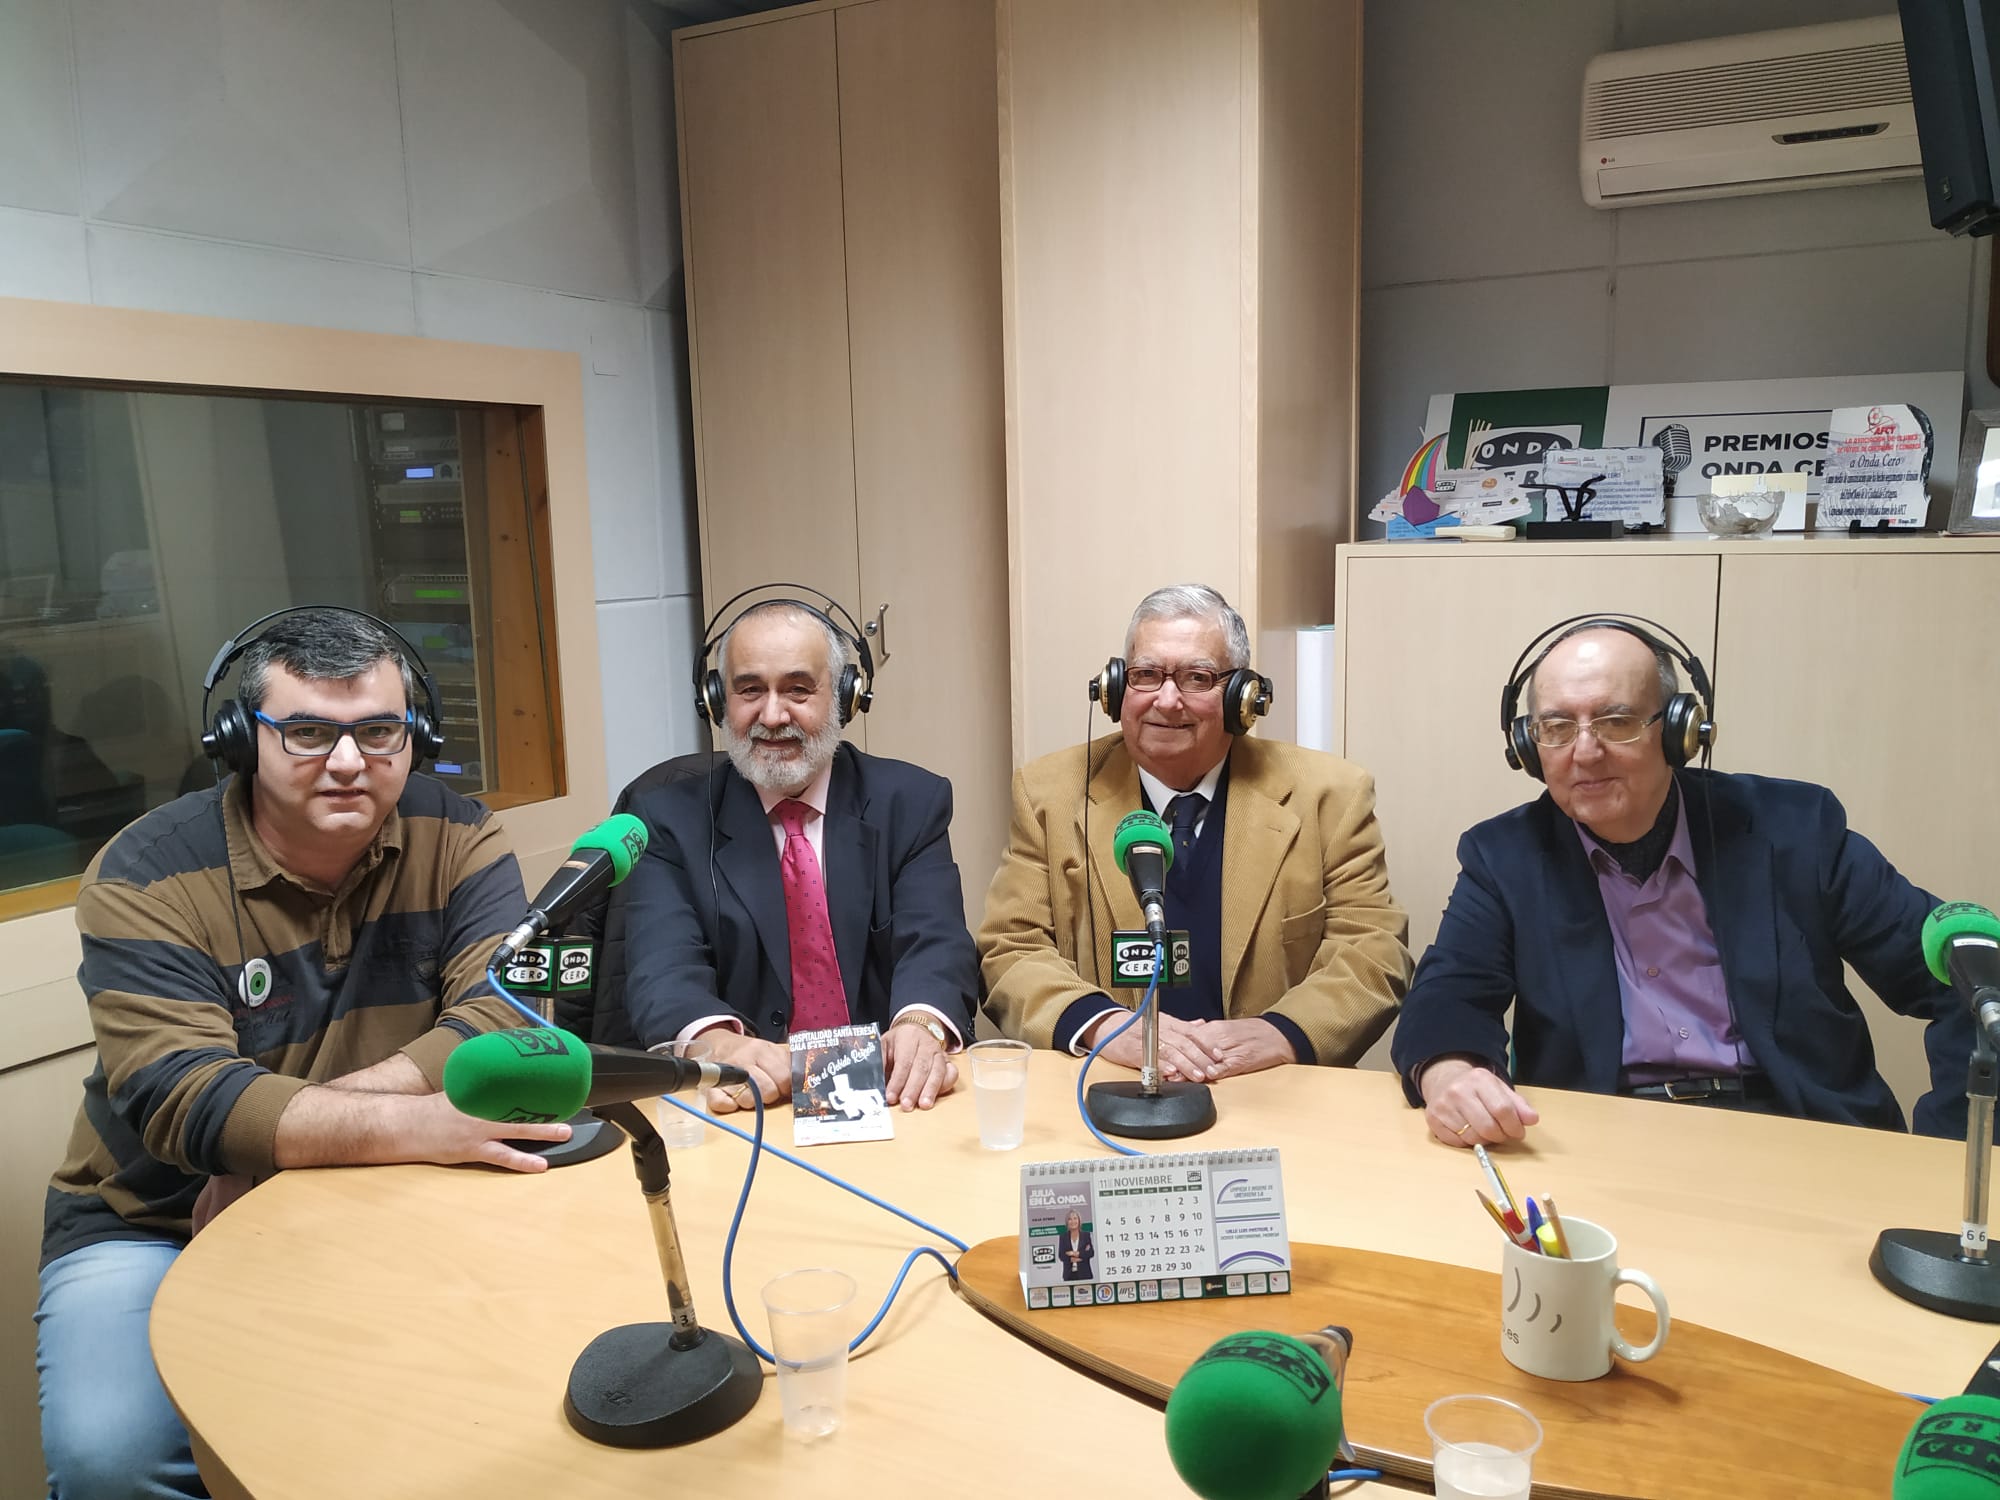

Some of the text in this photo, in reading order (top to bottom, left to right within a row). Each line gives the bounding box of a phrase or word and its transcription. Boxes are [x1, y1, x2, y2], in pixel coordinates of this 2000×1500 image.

[1481, 439, 1562, 458] ONDA
[1704, 431, 1829, 453] PREMIOS
[1858, 455, 1880, 468] Onda
[1883, 454, 1901, 468] Cero
[1701, 460, 1825, 479] ONDA CE
[1122, 948, 1156, 958] ONDA
[564, 956, 586, 965] ONDA
[513, 970, 543, 978] CERO
[565, 972, 585, 980] CERO
[789, 1025, 877, 1044] HOSPITALIDAD SANTA TERESA
[1100, 1175, 1173, 1188] 11 NOVIEMBRE
[1030, 1188, 1055, 1198] JULIA
[1043, 1197, 1056, 1205] LA
[1057, 1194, 1086, 1204] ONDA
[1179, 1197, 1184, 1205] 2
[1193, 1196, 1198, 1204] 3
[1121, 1217, 1126, 1225] 5
[1135, 1216, 1141, 1224] 6
[1150, 1215, 1155, 1223] 7
[1165, 1214, 1170, 1222] 8
[1179, 1213, 1185, 1221] 9
[1192, 1212, 1202, 1220] 10
[1105, 1234, 1114, 1242] 11
[1120, 1233, 1129, 1241] 12
[1135, 1232, 1144, 1240] 13
[1164, 1230, 1173, 1238] 15
[1179, 1229, 1189, 1237] 16
[1194, 1228, 1203, 1236] 17
[1966, 1230, 1986, 1241] 6 6
[1105, 1245, 1205, 1258] 18 19 20 21 22 23 24
[1106, 1262, 1191, 1275] 25 26 27 28 29 30
